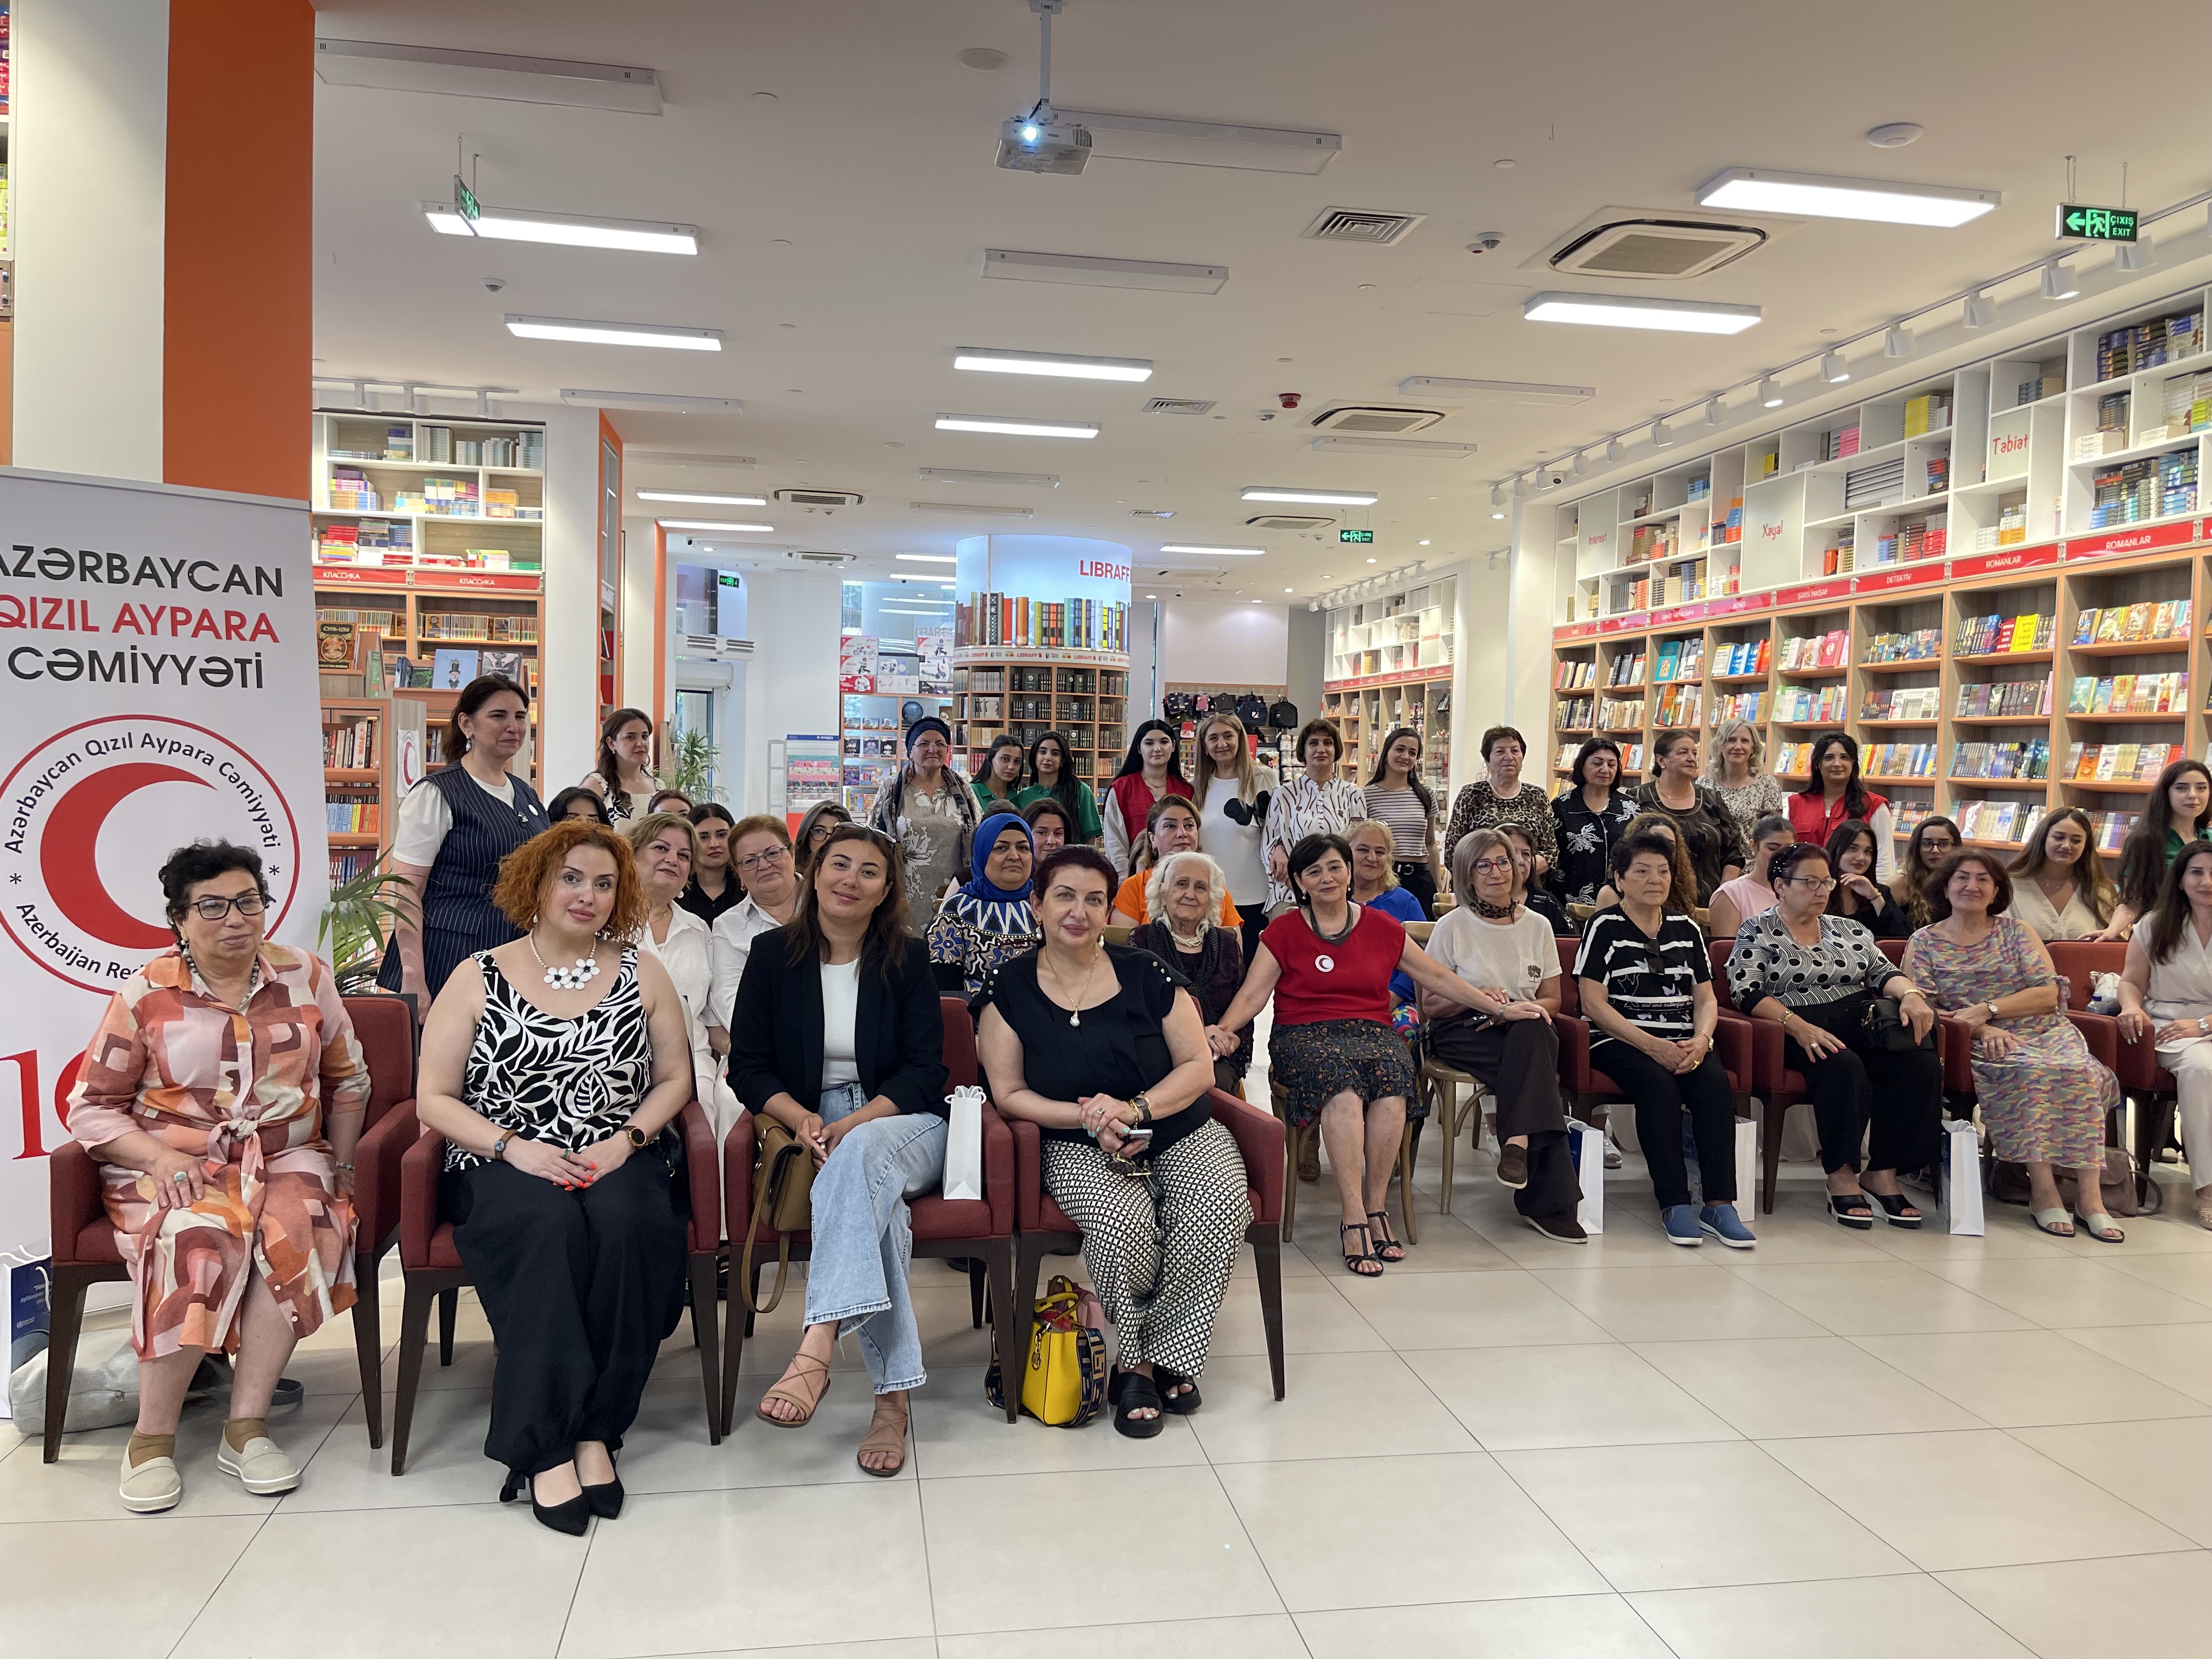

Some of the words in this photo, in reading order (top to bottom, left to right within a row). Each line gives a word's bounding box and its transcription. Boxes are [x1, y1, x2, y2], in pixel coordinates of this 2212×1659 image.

[2111, 215, 2134, 228] ÇIXIŞ
[2112, 228, 2131, 236] EXIT
[2106, 535, 2151, 550] ROMANLAR
[1985, 556, 2021, 569] ROMANLAR
[323, 571, 360, 579] КЛАССИКА
[0, 594, 100, 633] QIZIL
[111, 602, 280, 643] AYPARA
[8, 645, 263, 689] CƏMİYYƏTİ
[4, 751, 82, 854] Azərbaycan
[85, 732, 133, 757] Qızıl
[140, 732, 215, 766] Aypara
[219, 761, 281, 848] Cəmiyyəti
[16, 904, 101, 973] Azerbaijan
